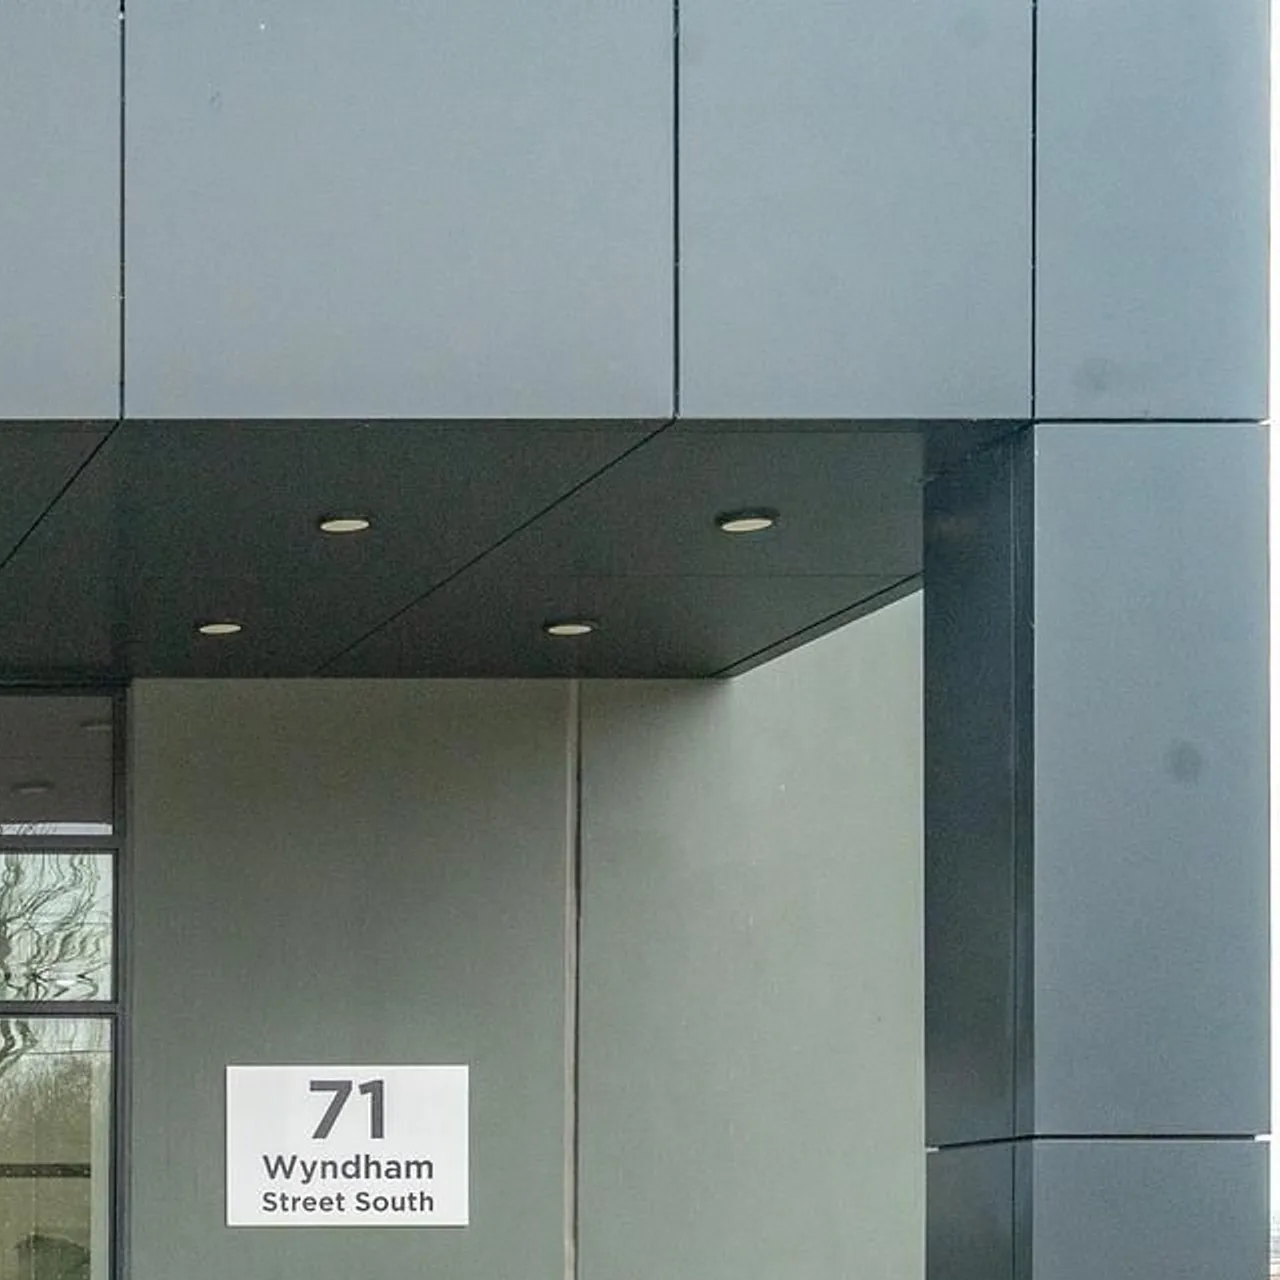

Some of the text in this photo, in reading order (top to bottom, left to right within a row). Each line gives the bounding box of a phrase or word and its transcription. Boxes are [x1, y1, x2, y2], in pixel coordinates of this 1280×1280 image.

[309, 1079, 384, 1139] 71
[262, 1154, 434, 1184] Wyndham
[261, 1191, 435, 1212] Street South
